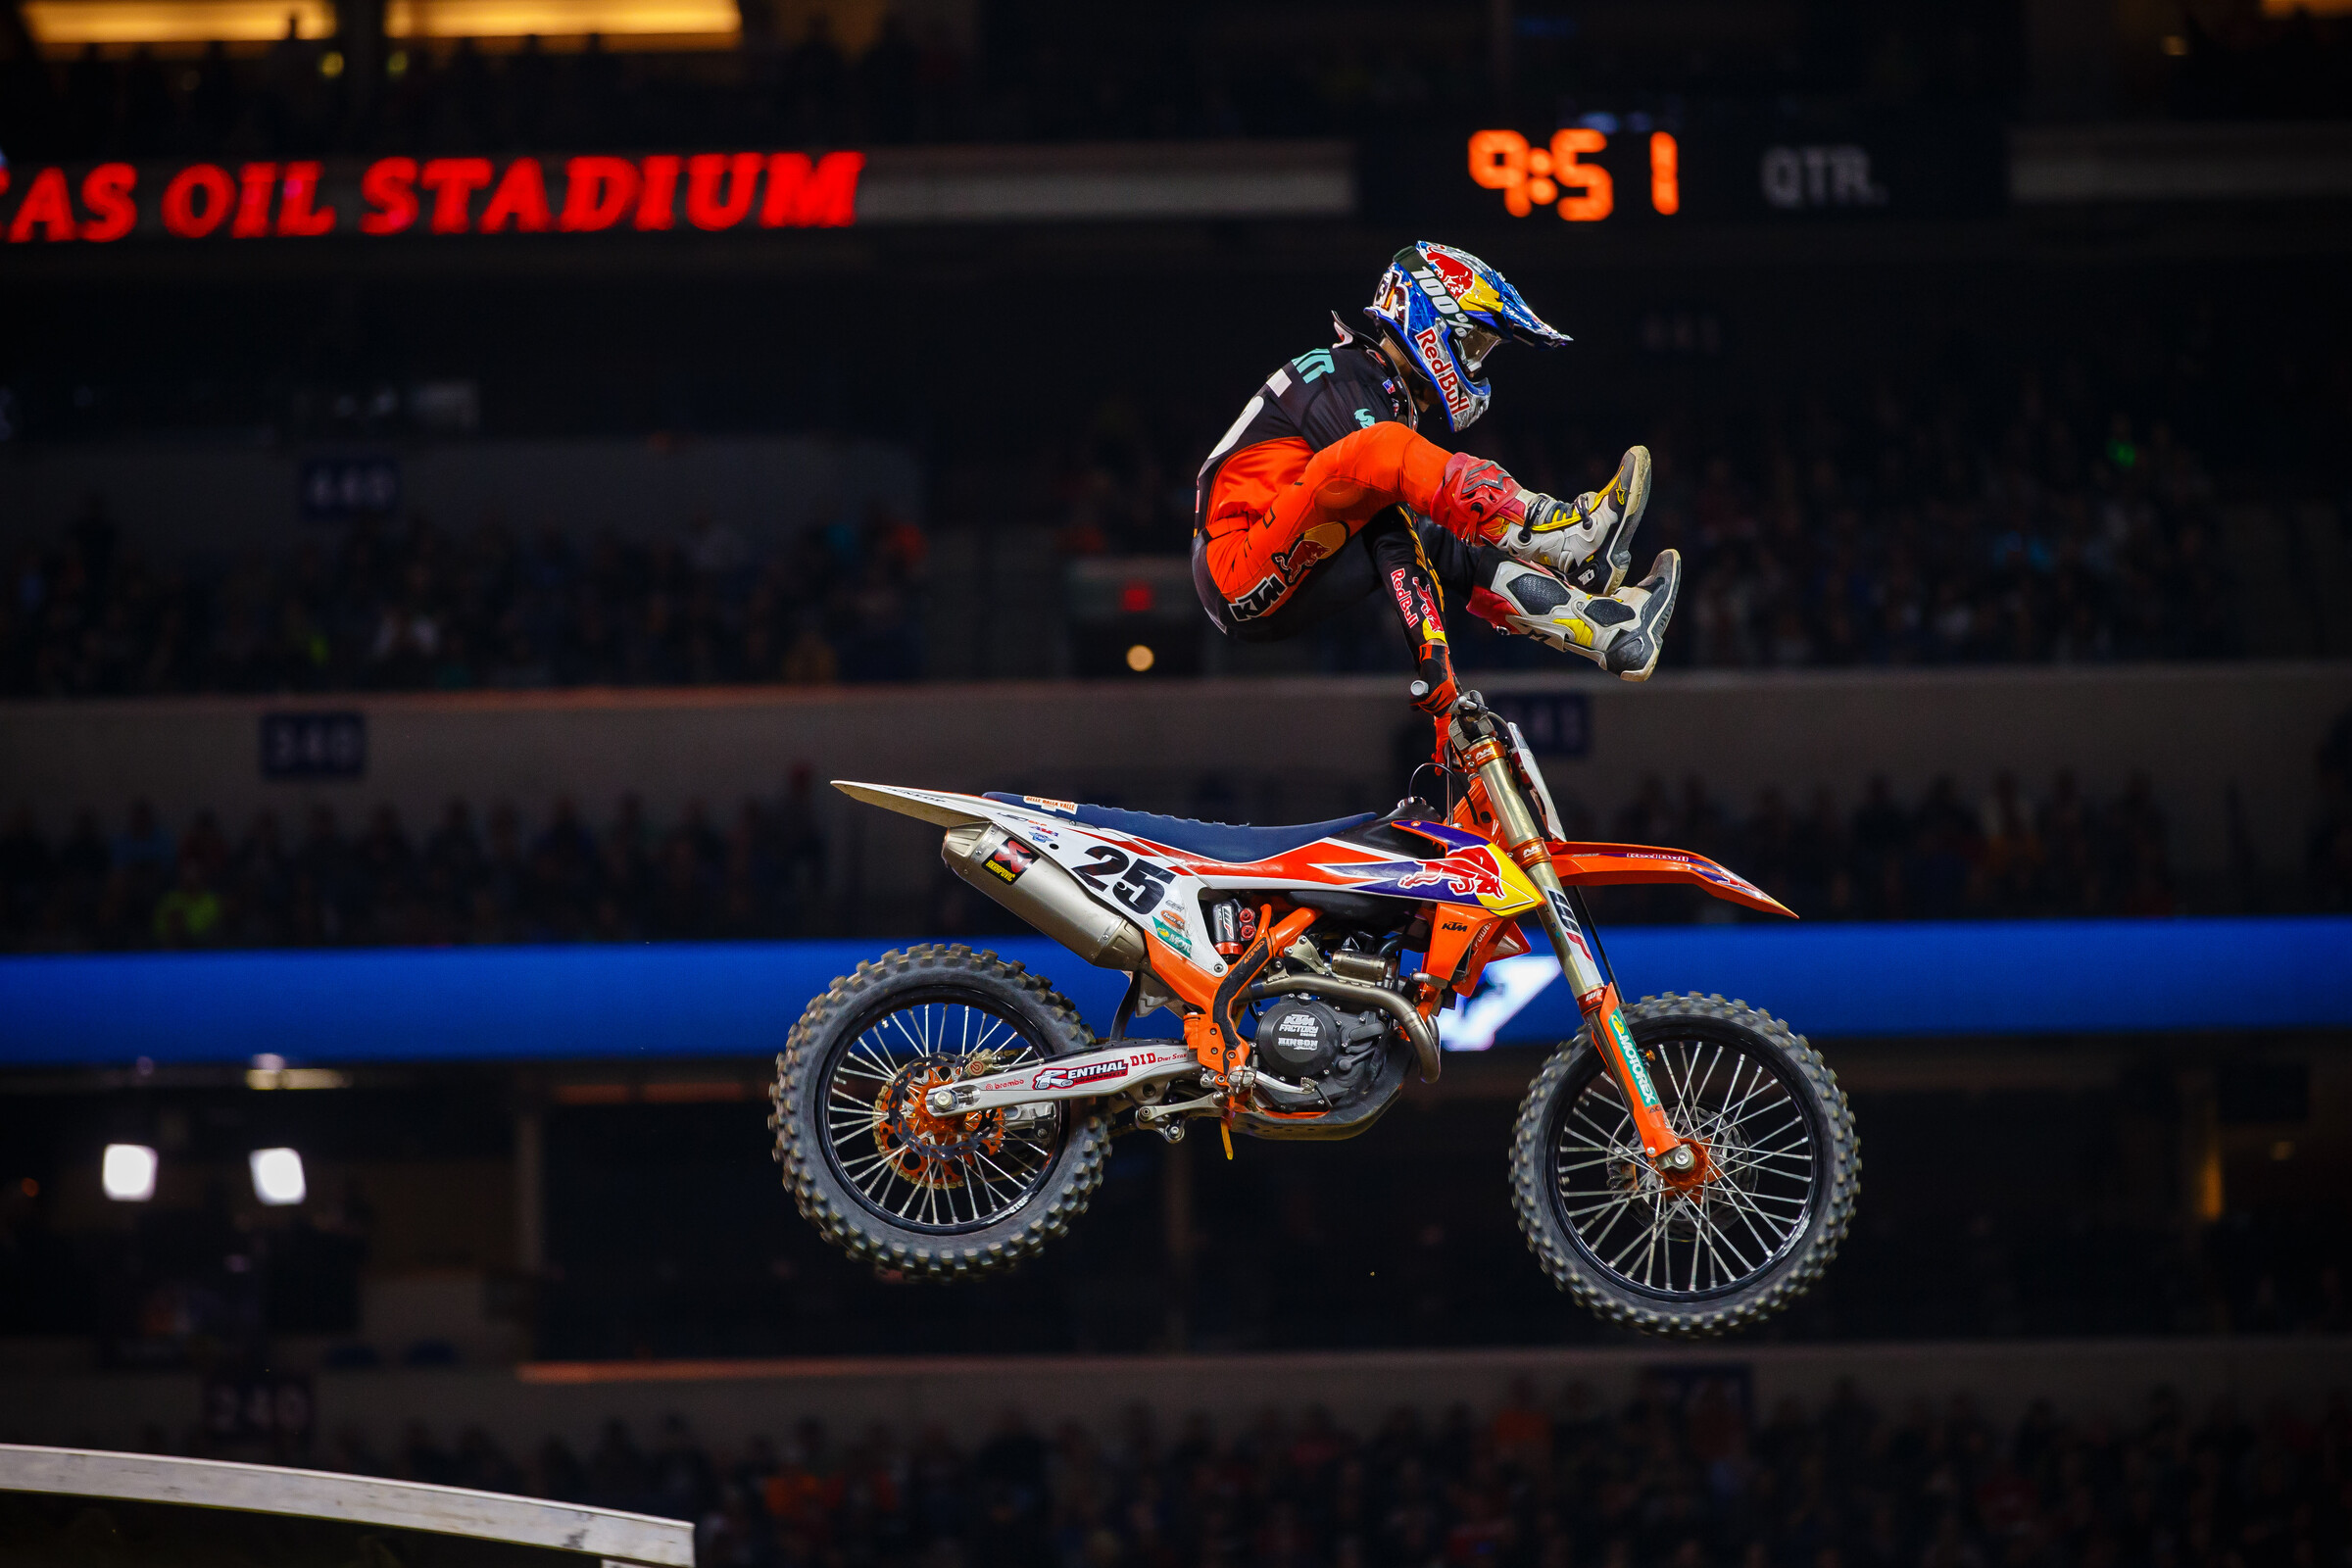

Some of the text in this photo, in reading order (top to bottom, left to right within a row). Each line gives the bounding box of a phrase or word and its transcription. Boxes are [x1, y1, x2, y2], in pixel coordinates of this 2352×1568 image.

[0, 151, 865, 242] AS OIL STADIUM
[1469, 128, 1614, 221] 9:51
[1650, 131, 1680, 215] 1
[1411, 266, 1474, 338] 100%
[1228, 572, 1289, 622] KTM
[1071, 845, 1177, 915] 25
[1442, 920, 1469, 933] KTM
[994, 1078, 1025, 1090] brembo
[1618, 1034, 1656, 1104] MOTOREX
